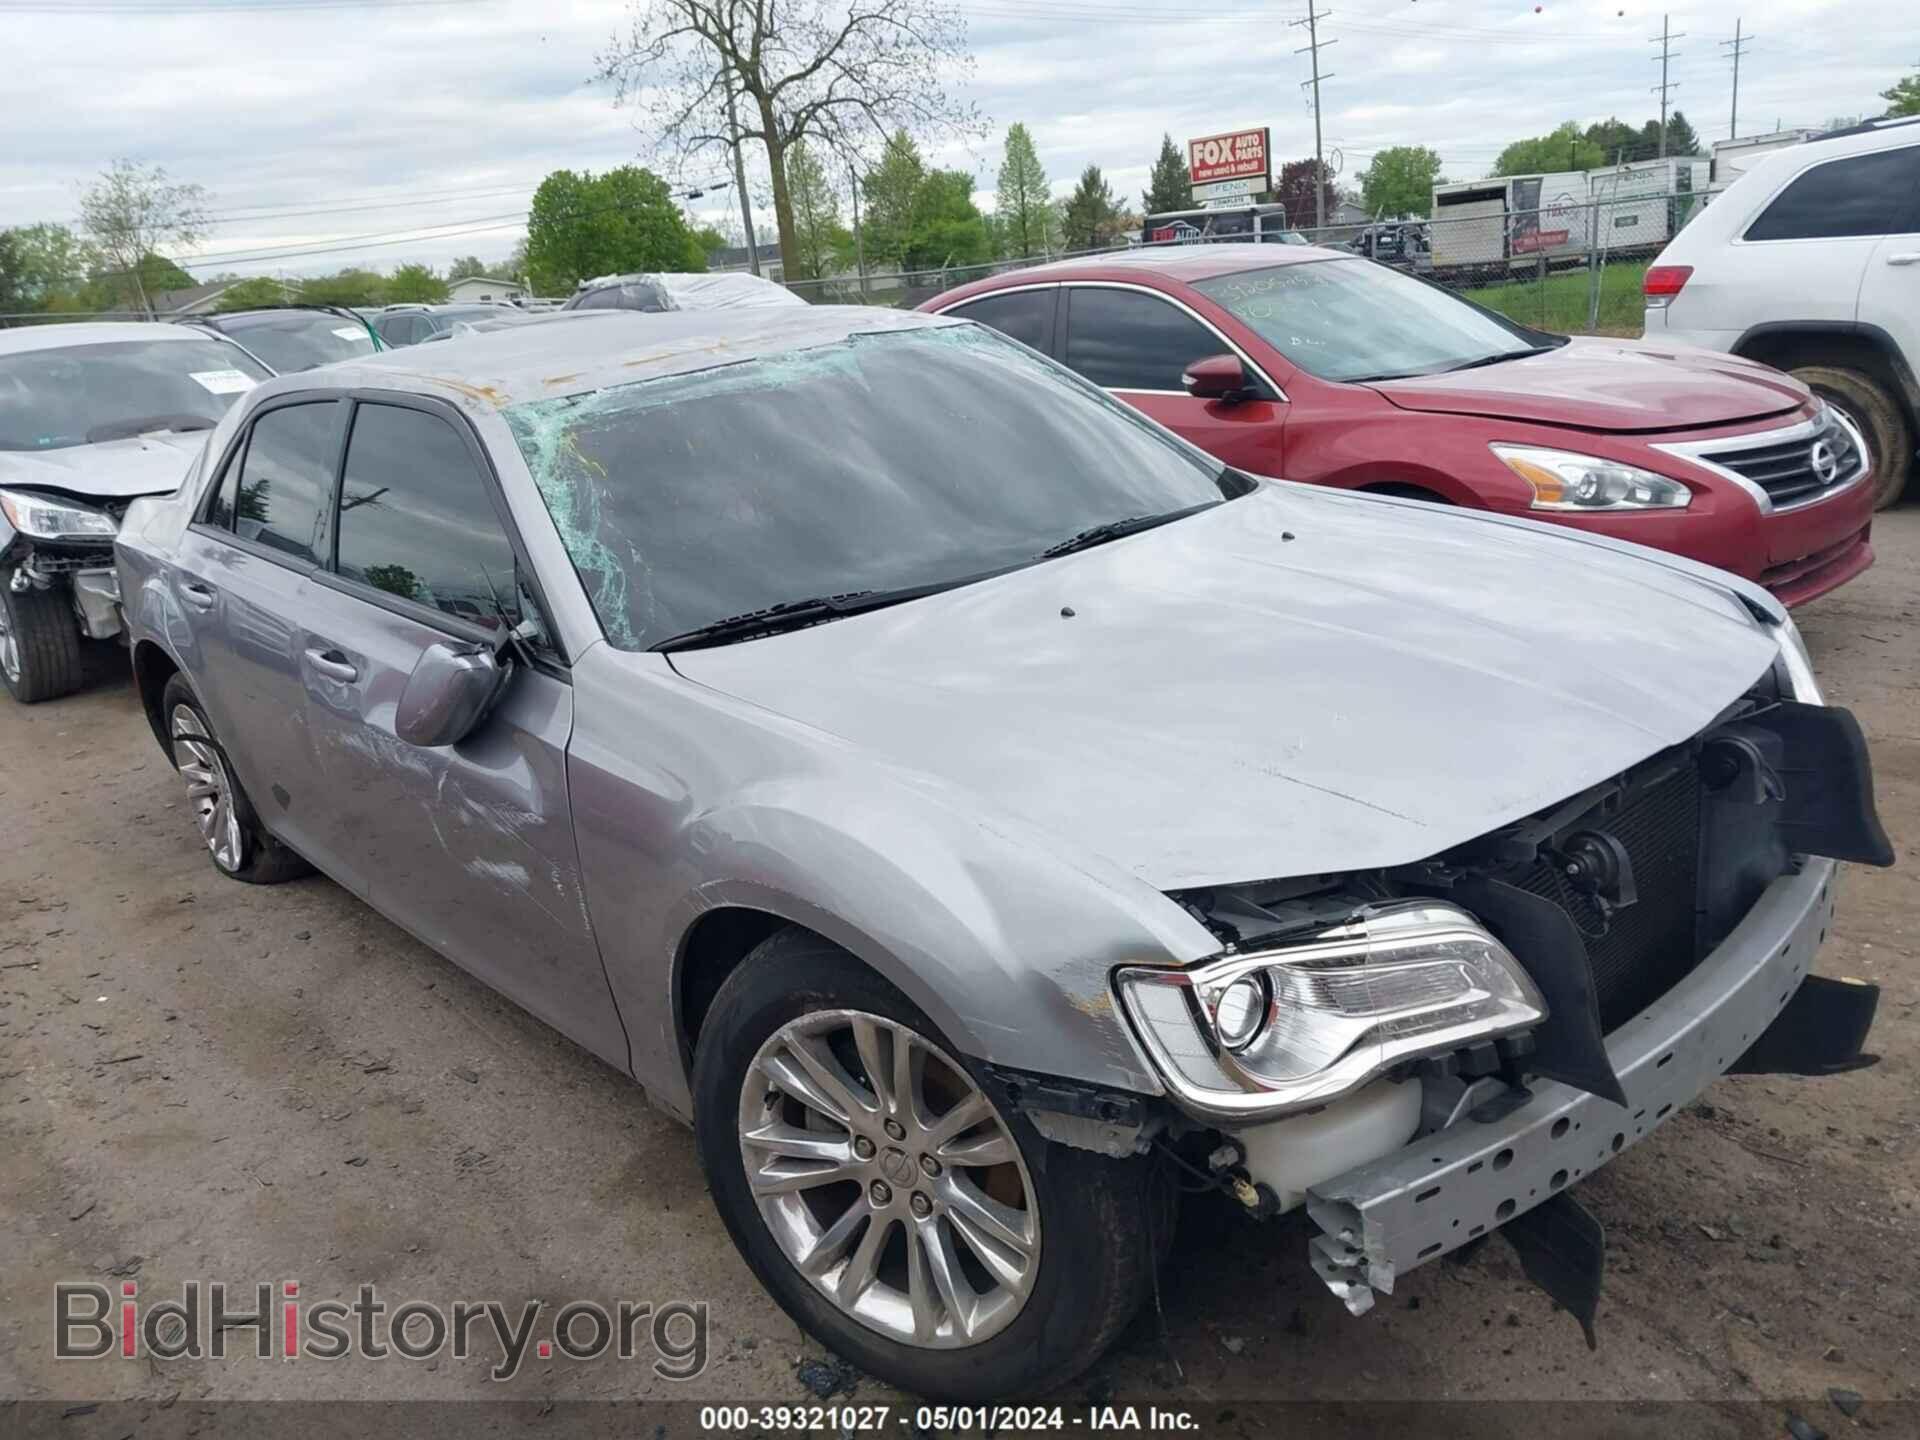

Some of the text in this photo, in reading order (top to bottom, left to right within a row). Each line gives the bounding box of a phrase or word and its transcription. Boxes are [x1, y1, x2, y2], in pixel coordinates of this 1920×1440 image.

[1235, 134, 1259, 149] AUTO
[1192, 138, 1235, 168] FOX
[1235, 145, 1263, 161] PARTS
[1215, 181, 1249, 192] FENIX
